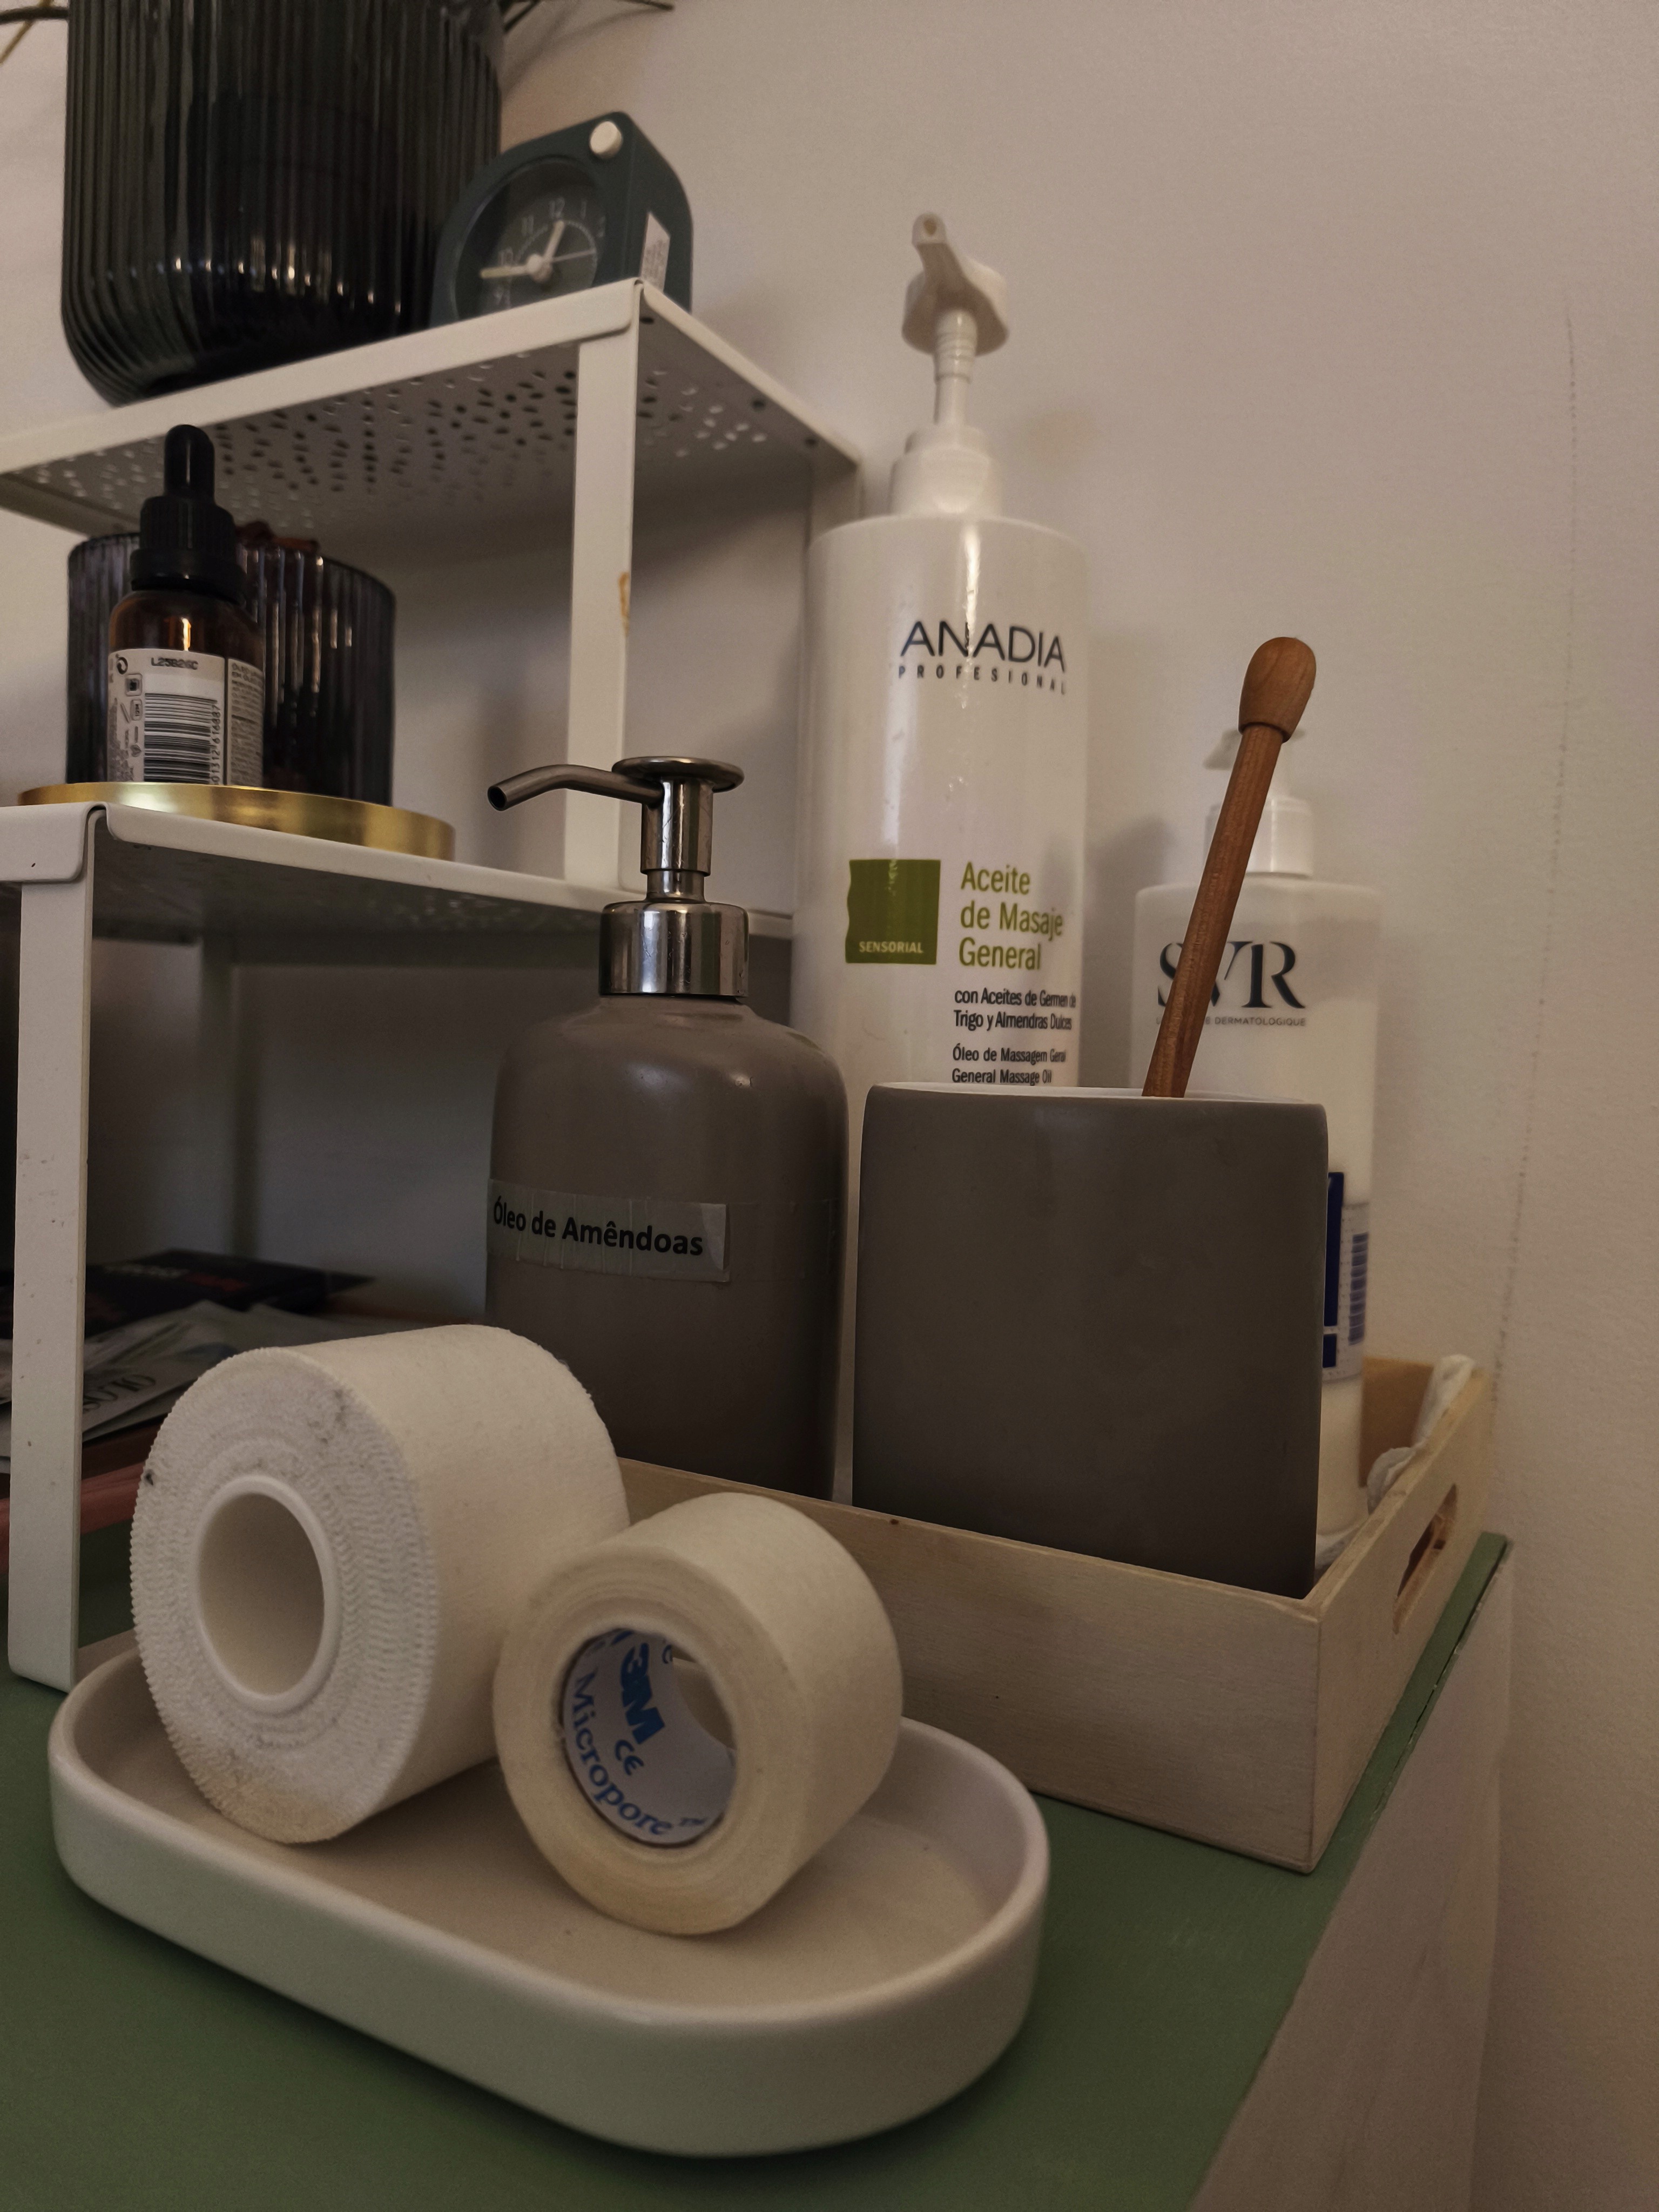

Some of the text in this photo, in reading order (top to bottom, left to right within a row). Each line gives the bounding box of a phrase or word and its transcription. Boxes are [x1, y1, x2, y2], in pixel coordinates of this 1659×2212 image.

[900, 621, 1065, 672] ANADIA
[898, 664, 1066, 695] PROFESIONAL
[960, 861, 1031, 895] Aceite
[960, 900, 1064, 941] de Masaje
[859, 941, 924, 954] SENSORIAL
[959, 936, 1041, 970] General
[954, 989, 979, 1004] con
[980, 987, 1022, 1006] Aceites
[1024, 989, 1037, 1007] de
[1040, 989, 1068, 1007] Germen
[953, 1009, 1073, 1031] Trigo y Almendras Dulces
[952, 1043, 980, 1061] Óleo
[983, 1047, 997, 1062] de
[1000, 1047, 1048, 1066] Massagem
[952, 1068, 1053, 1086] General Massage Oil
[493, 1195, 704, 1256] Óleo de Amêndoas
[621, 1643, 665, 1745] 3M
[572, 1667, 674, 1835] Micropore
